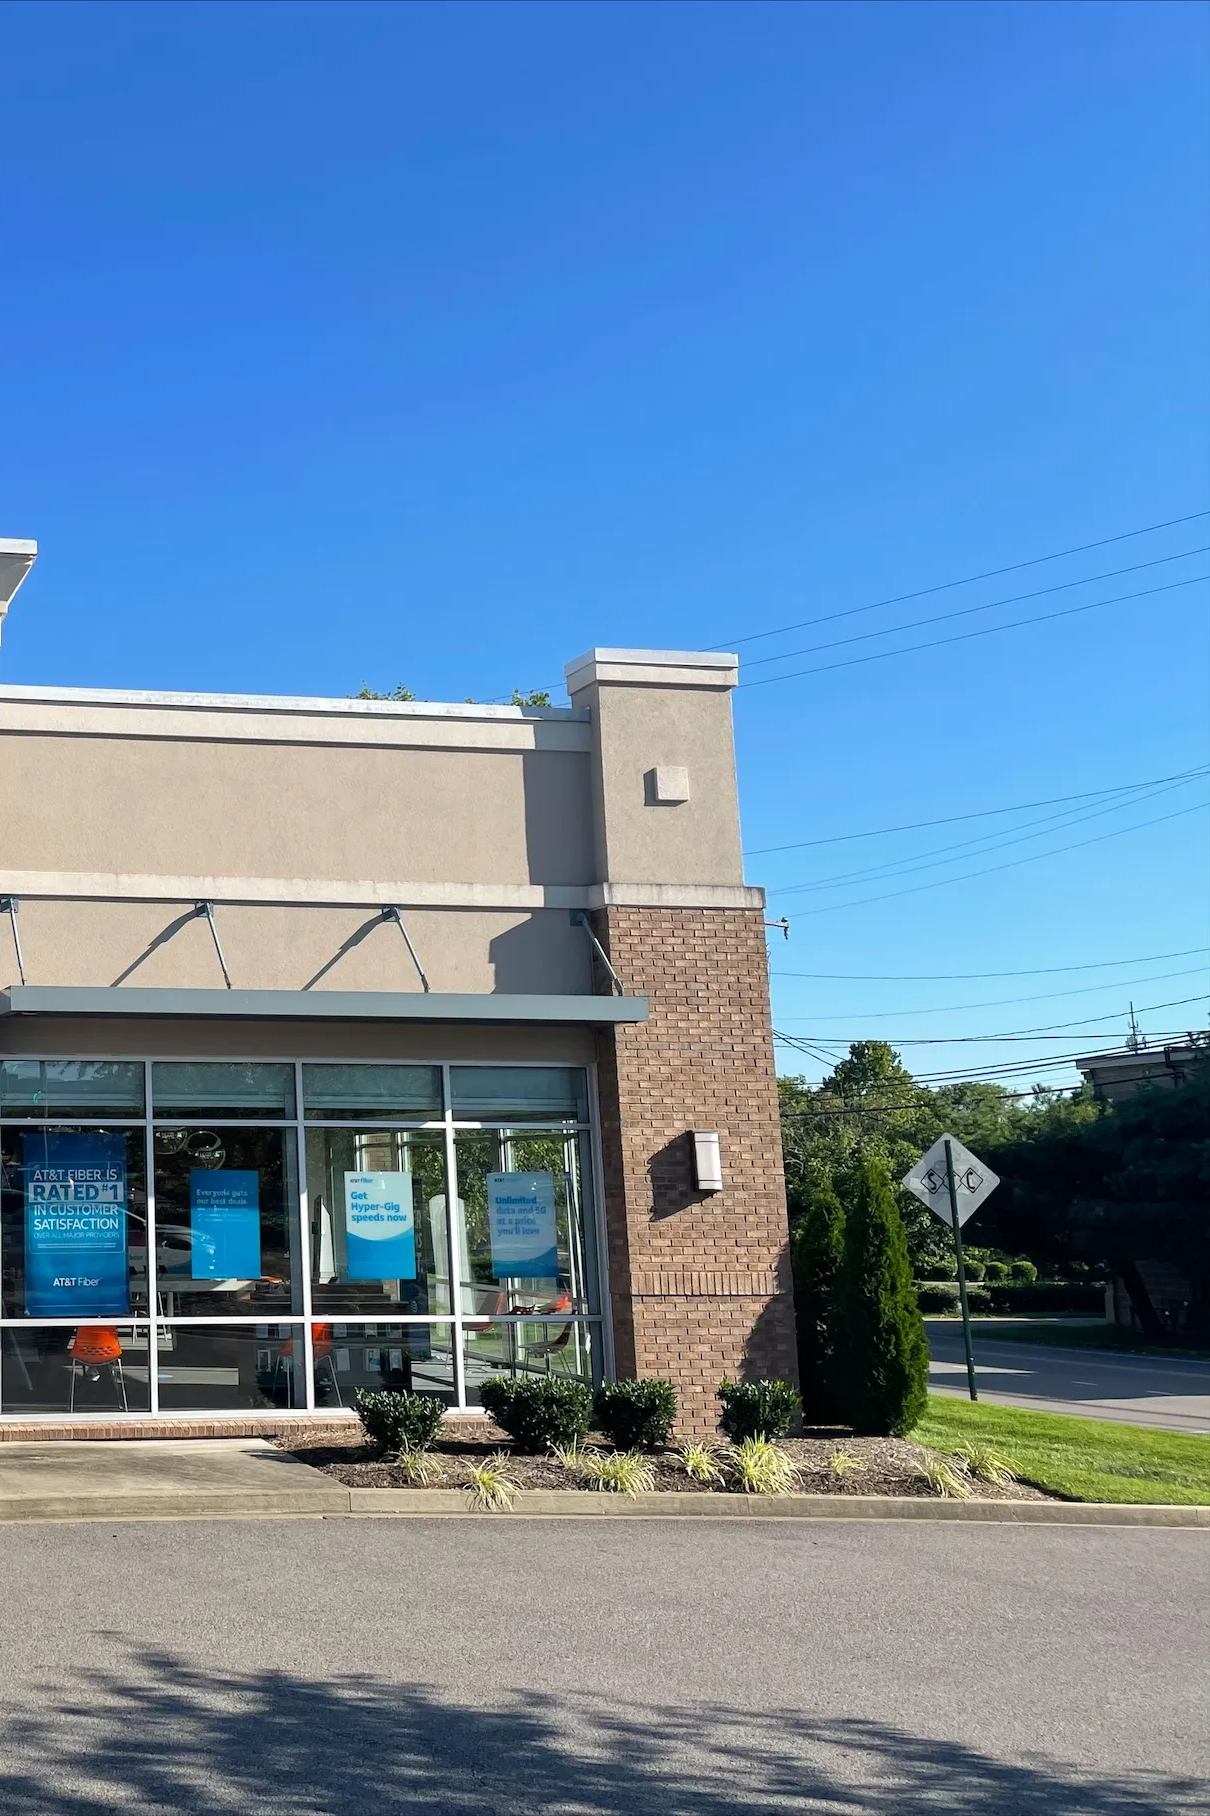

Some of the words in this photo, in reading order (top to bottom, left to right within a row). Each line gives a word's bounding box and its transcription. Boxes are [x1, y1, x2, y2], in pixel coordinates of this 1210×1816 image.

[33, 1169, 65, 1180] AT&T
[68, 1169, 101, 1180] FIBER
[106, 1168, 118, 1180] IS
[33, 1184, 99, 1200] RATED
[102, 1183, 119, 1200] #1
[196, 1188, 230, 1198] Everyone
[350, 1191, 368, 1200] Get
[211, 1197, 226, 1205] best
[495, 1195, 537, 1204] Unlimited
[34, 1204, 47, 1216] IN
[49, 1204, 119, 1216] CUSTOMER
[351, 1202, 400, 1213] Hyper-Gig
[496, 1205, 516, 1214] data
[517, 1205, 533, 1214] and
[351, 1213, 385, 1224] speeds
[387, 1214, 407, 1222] now
[515, 1216, 536, 1227] price
[33, 1218, 119, 1230] SATISFACTION
[522, 1226, 540, 1235] love
[53, 1277, 77, 1287] AT&T
[77, 1277, 100, 1287] Fiber
